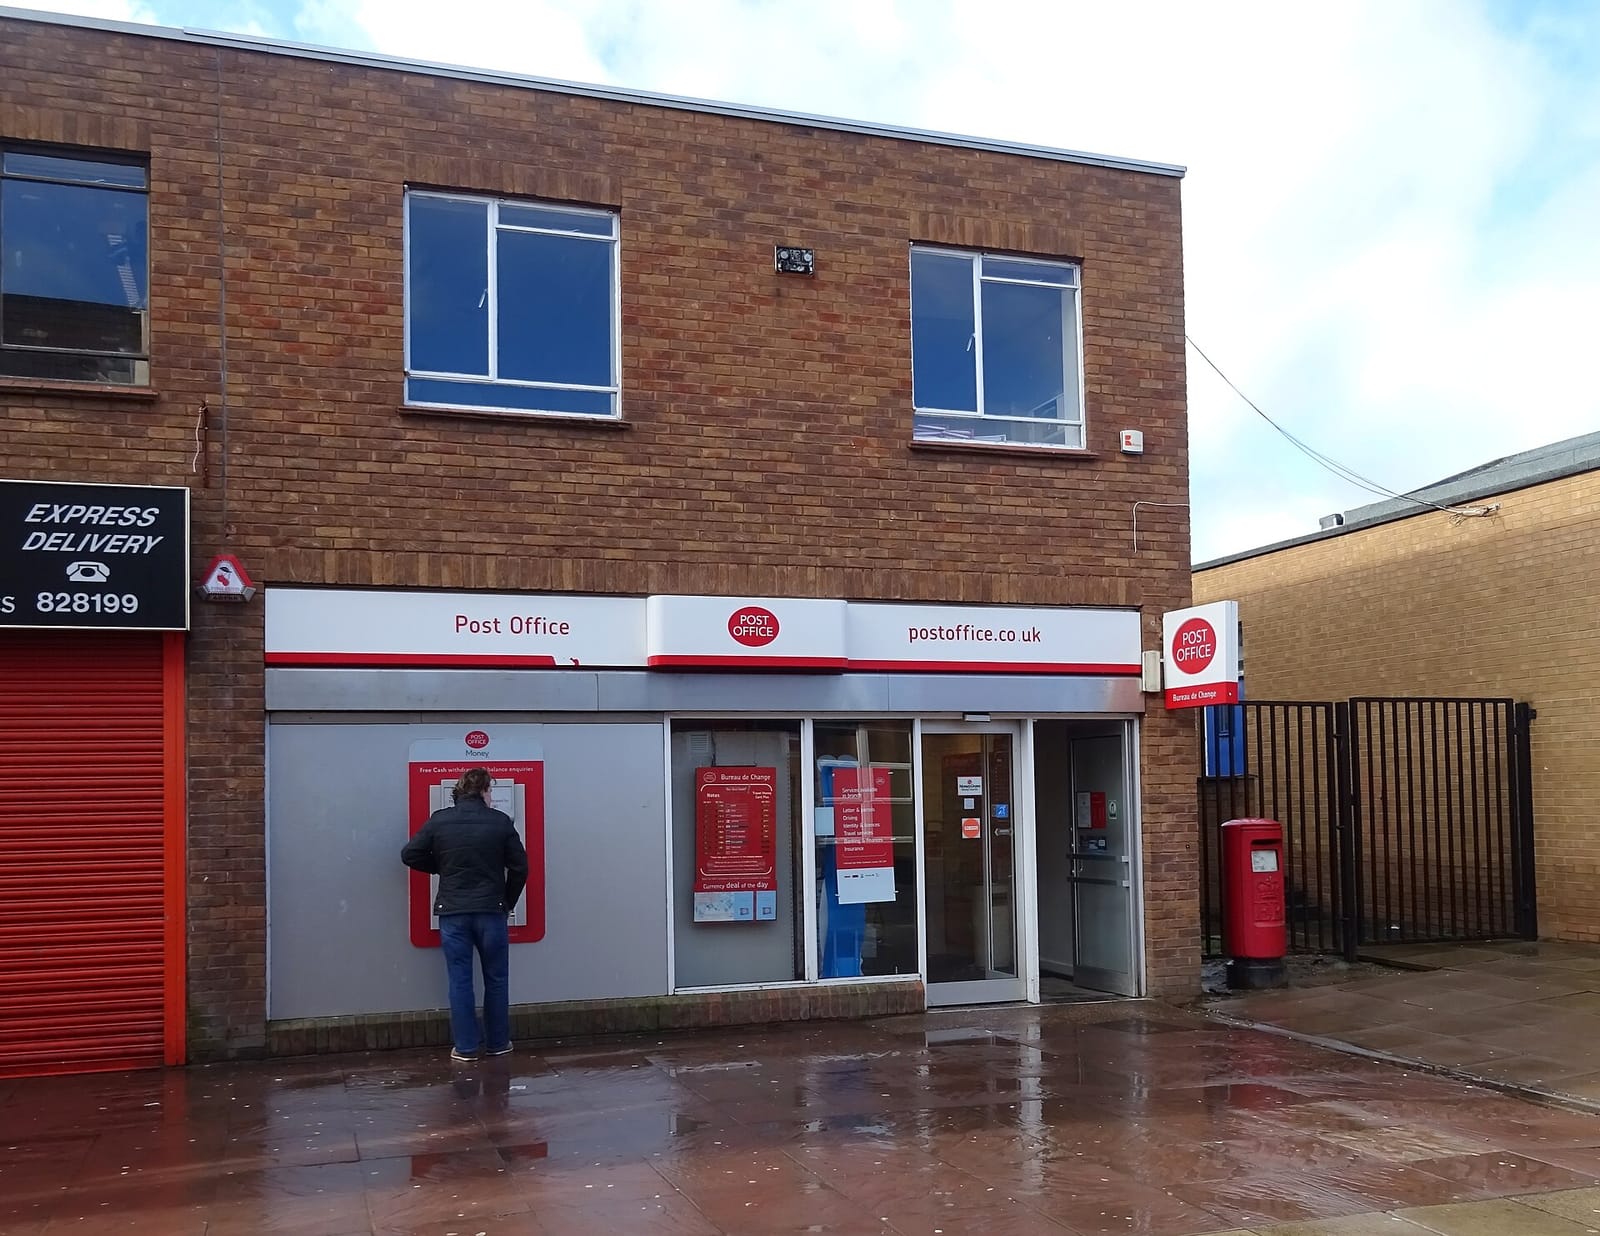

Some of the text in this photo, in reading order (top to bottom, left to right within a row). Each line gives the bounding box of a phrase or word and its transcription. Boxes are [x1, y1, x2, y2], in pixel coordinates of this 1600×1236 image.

[25, 504, 159, 527] EXPRESS
[22, 531, 163, 554] DELIVERY
[37, 592, 138, 613] 828199
[455, 615, 569, 635] Post Office
[740, 615, 769, 626] POST
[733, 626, 773, 637] OFFICE
[909, 625, 1041, 643] postoffice.co.uk
[1182, 629, 1208, 646] POST
[1176, 644, 1211, 662] OFFICE
[1172, 690, 1217, 701] Bureau de Change
[465, 750, 489, 758] Money
[726, 881, 740, 889] deal
[757, 881, 769, 889] day
